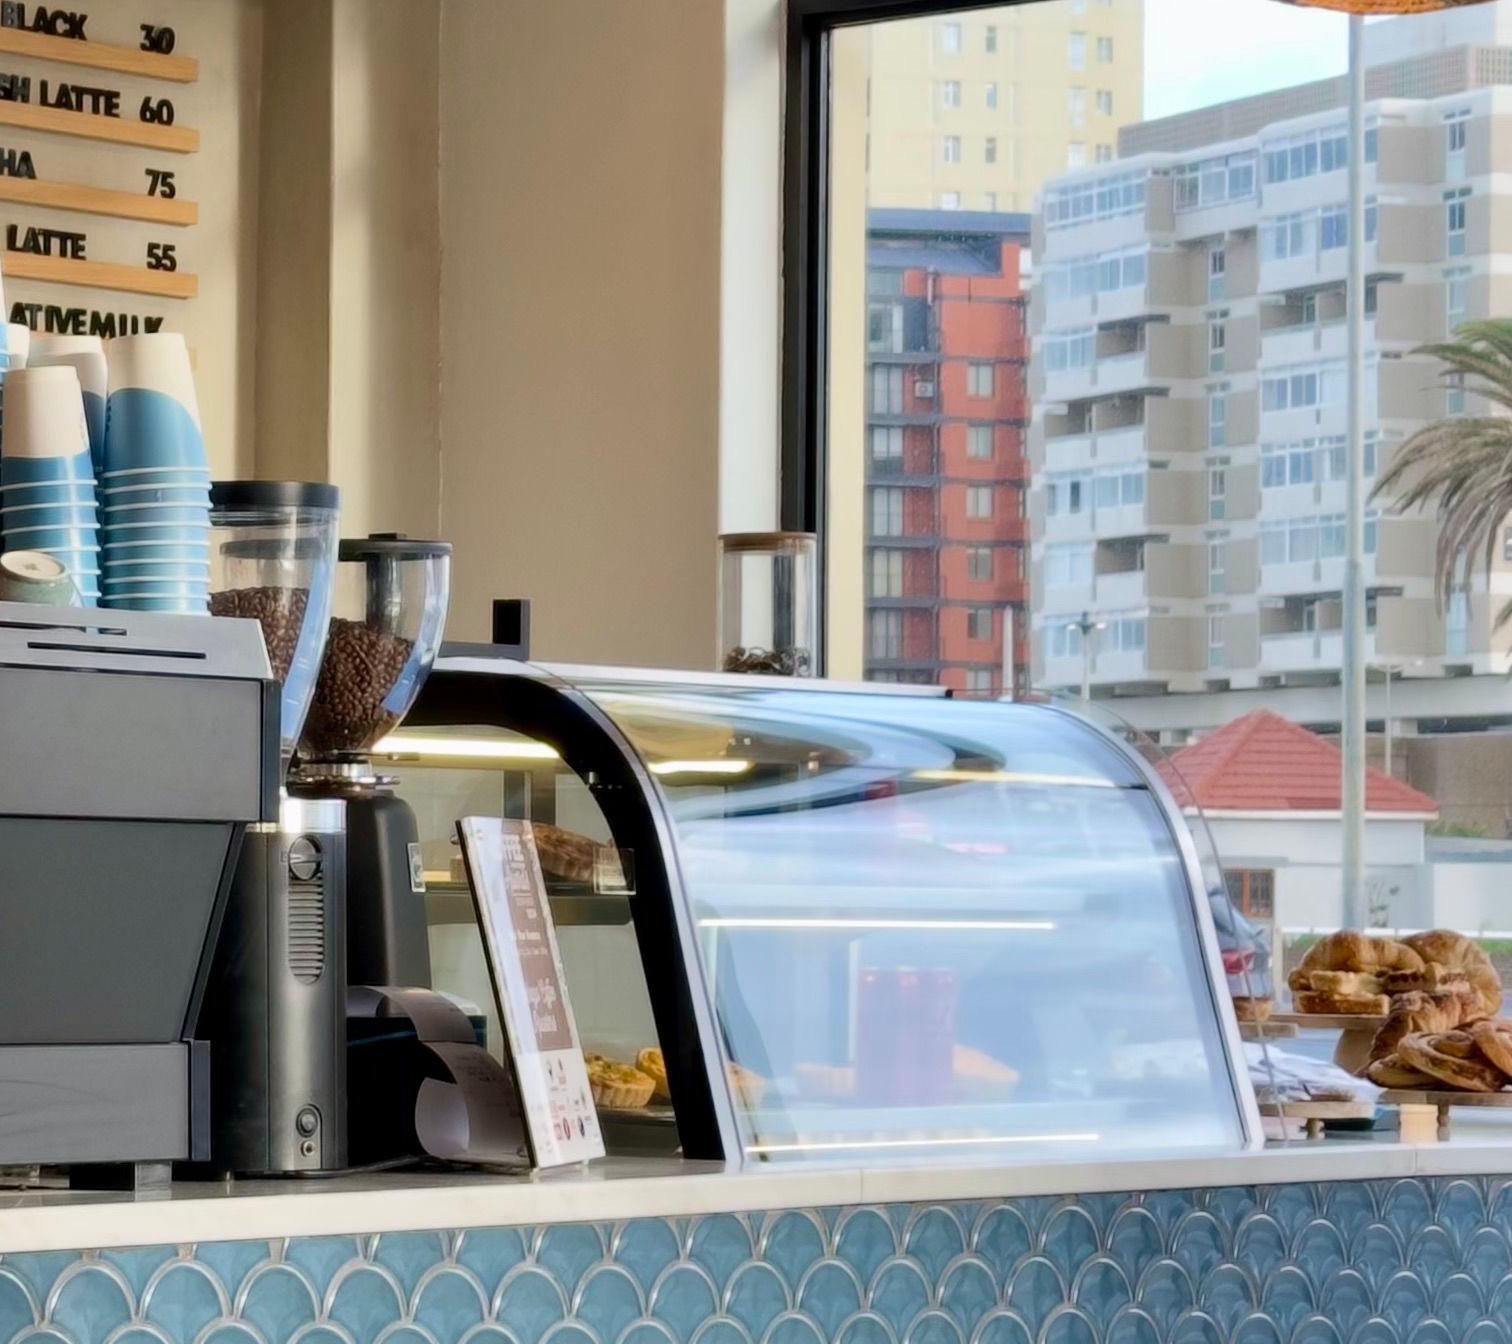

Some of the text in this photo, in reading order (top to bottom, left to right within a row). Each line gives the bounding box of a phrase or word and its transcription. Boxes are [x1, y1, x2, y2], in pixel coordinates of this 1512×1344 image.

[1, 0, 88, 40] BLACK
[140, 23, 176, 55] 30
[39, 79, 120, 118] LATTE
[139, 96, 175, 126] 60
[144, 168, 176, 199] 75
[6, 224, 87, 260] LATTE
[146, 242, 177, 272] 55
